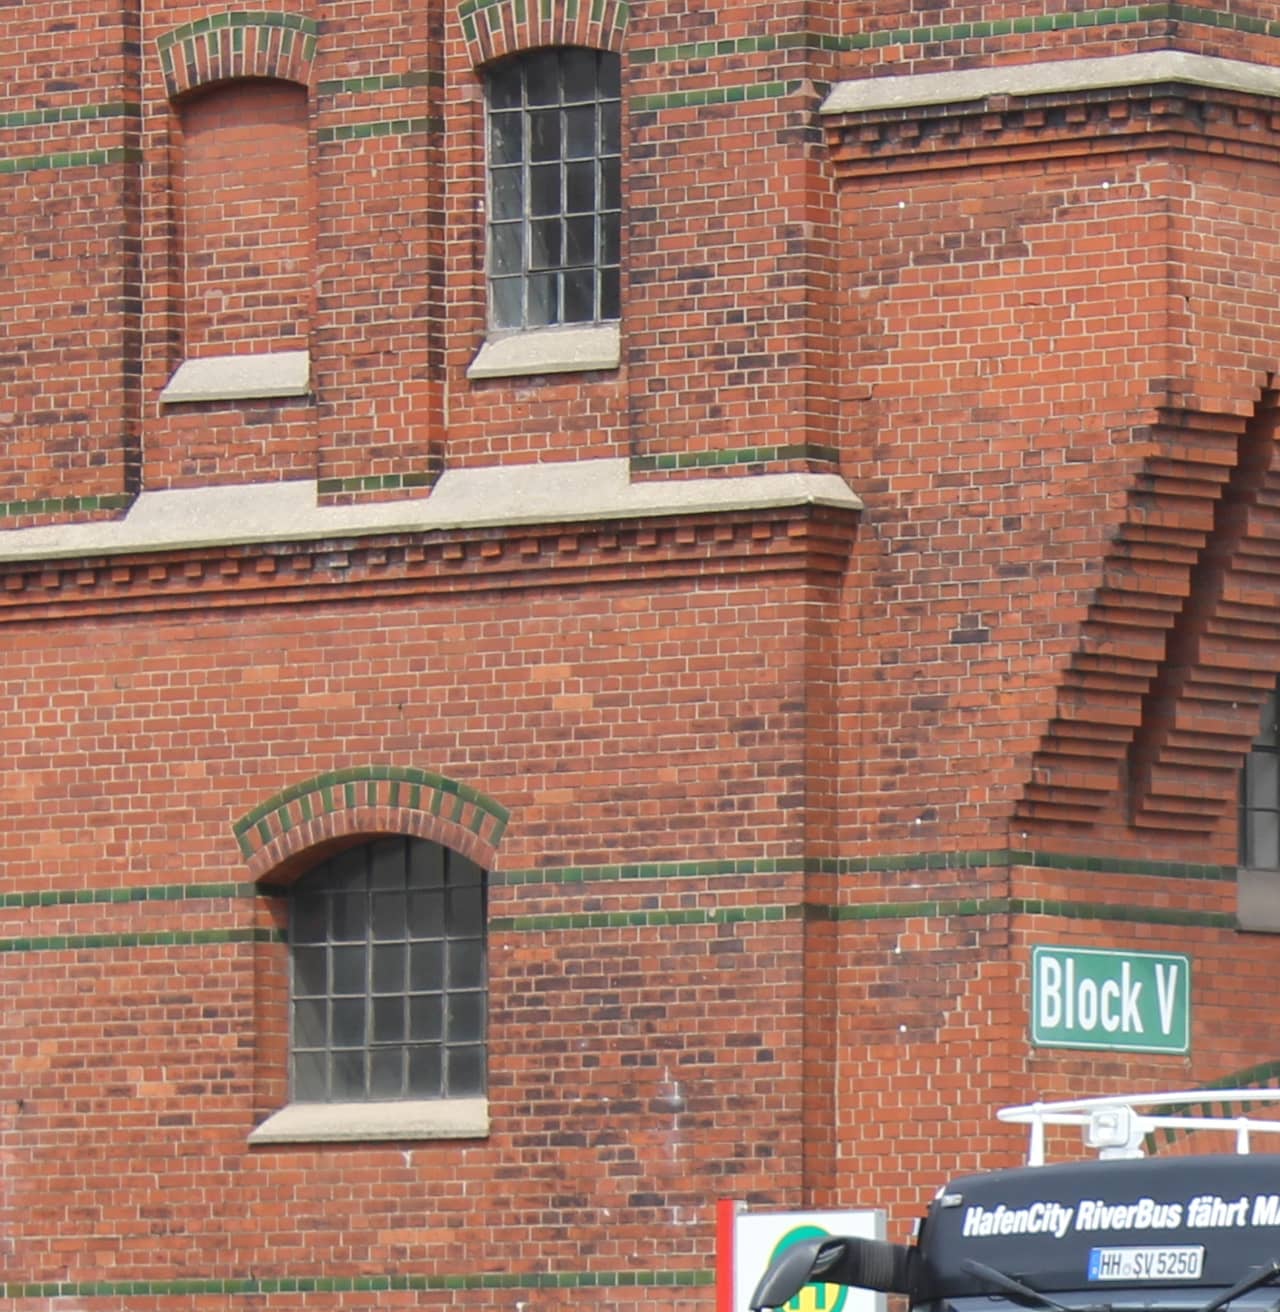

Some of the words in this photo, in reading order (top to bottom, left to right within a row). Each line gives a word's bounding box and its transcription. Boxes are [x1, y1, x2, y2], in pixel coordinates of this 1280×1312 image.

[1040, 956, 1144, 1033] Block
[1155, 963, 1178, 1035] V
[963, 1203, 1073, 1238] HafenCity
[1075, 1198, 1183, 1231] RiverBus
[1187, 1195, 1249, 1228] fährt
[1101, 1253, 1121, 1275] HH
[1156, 1251, 1198, 1275] 5250
